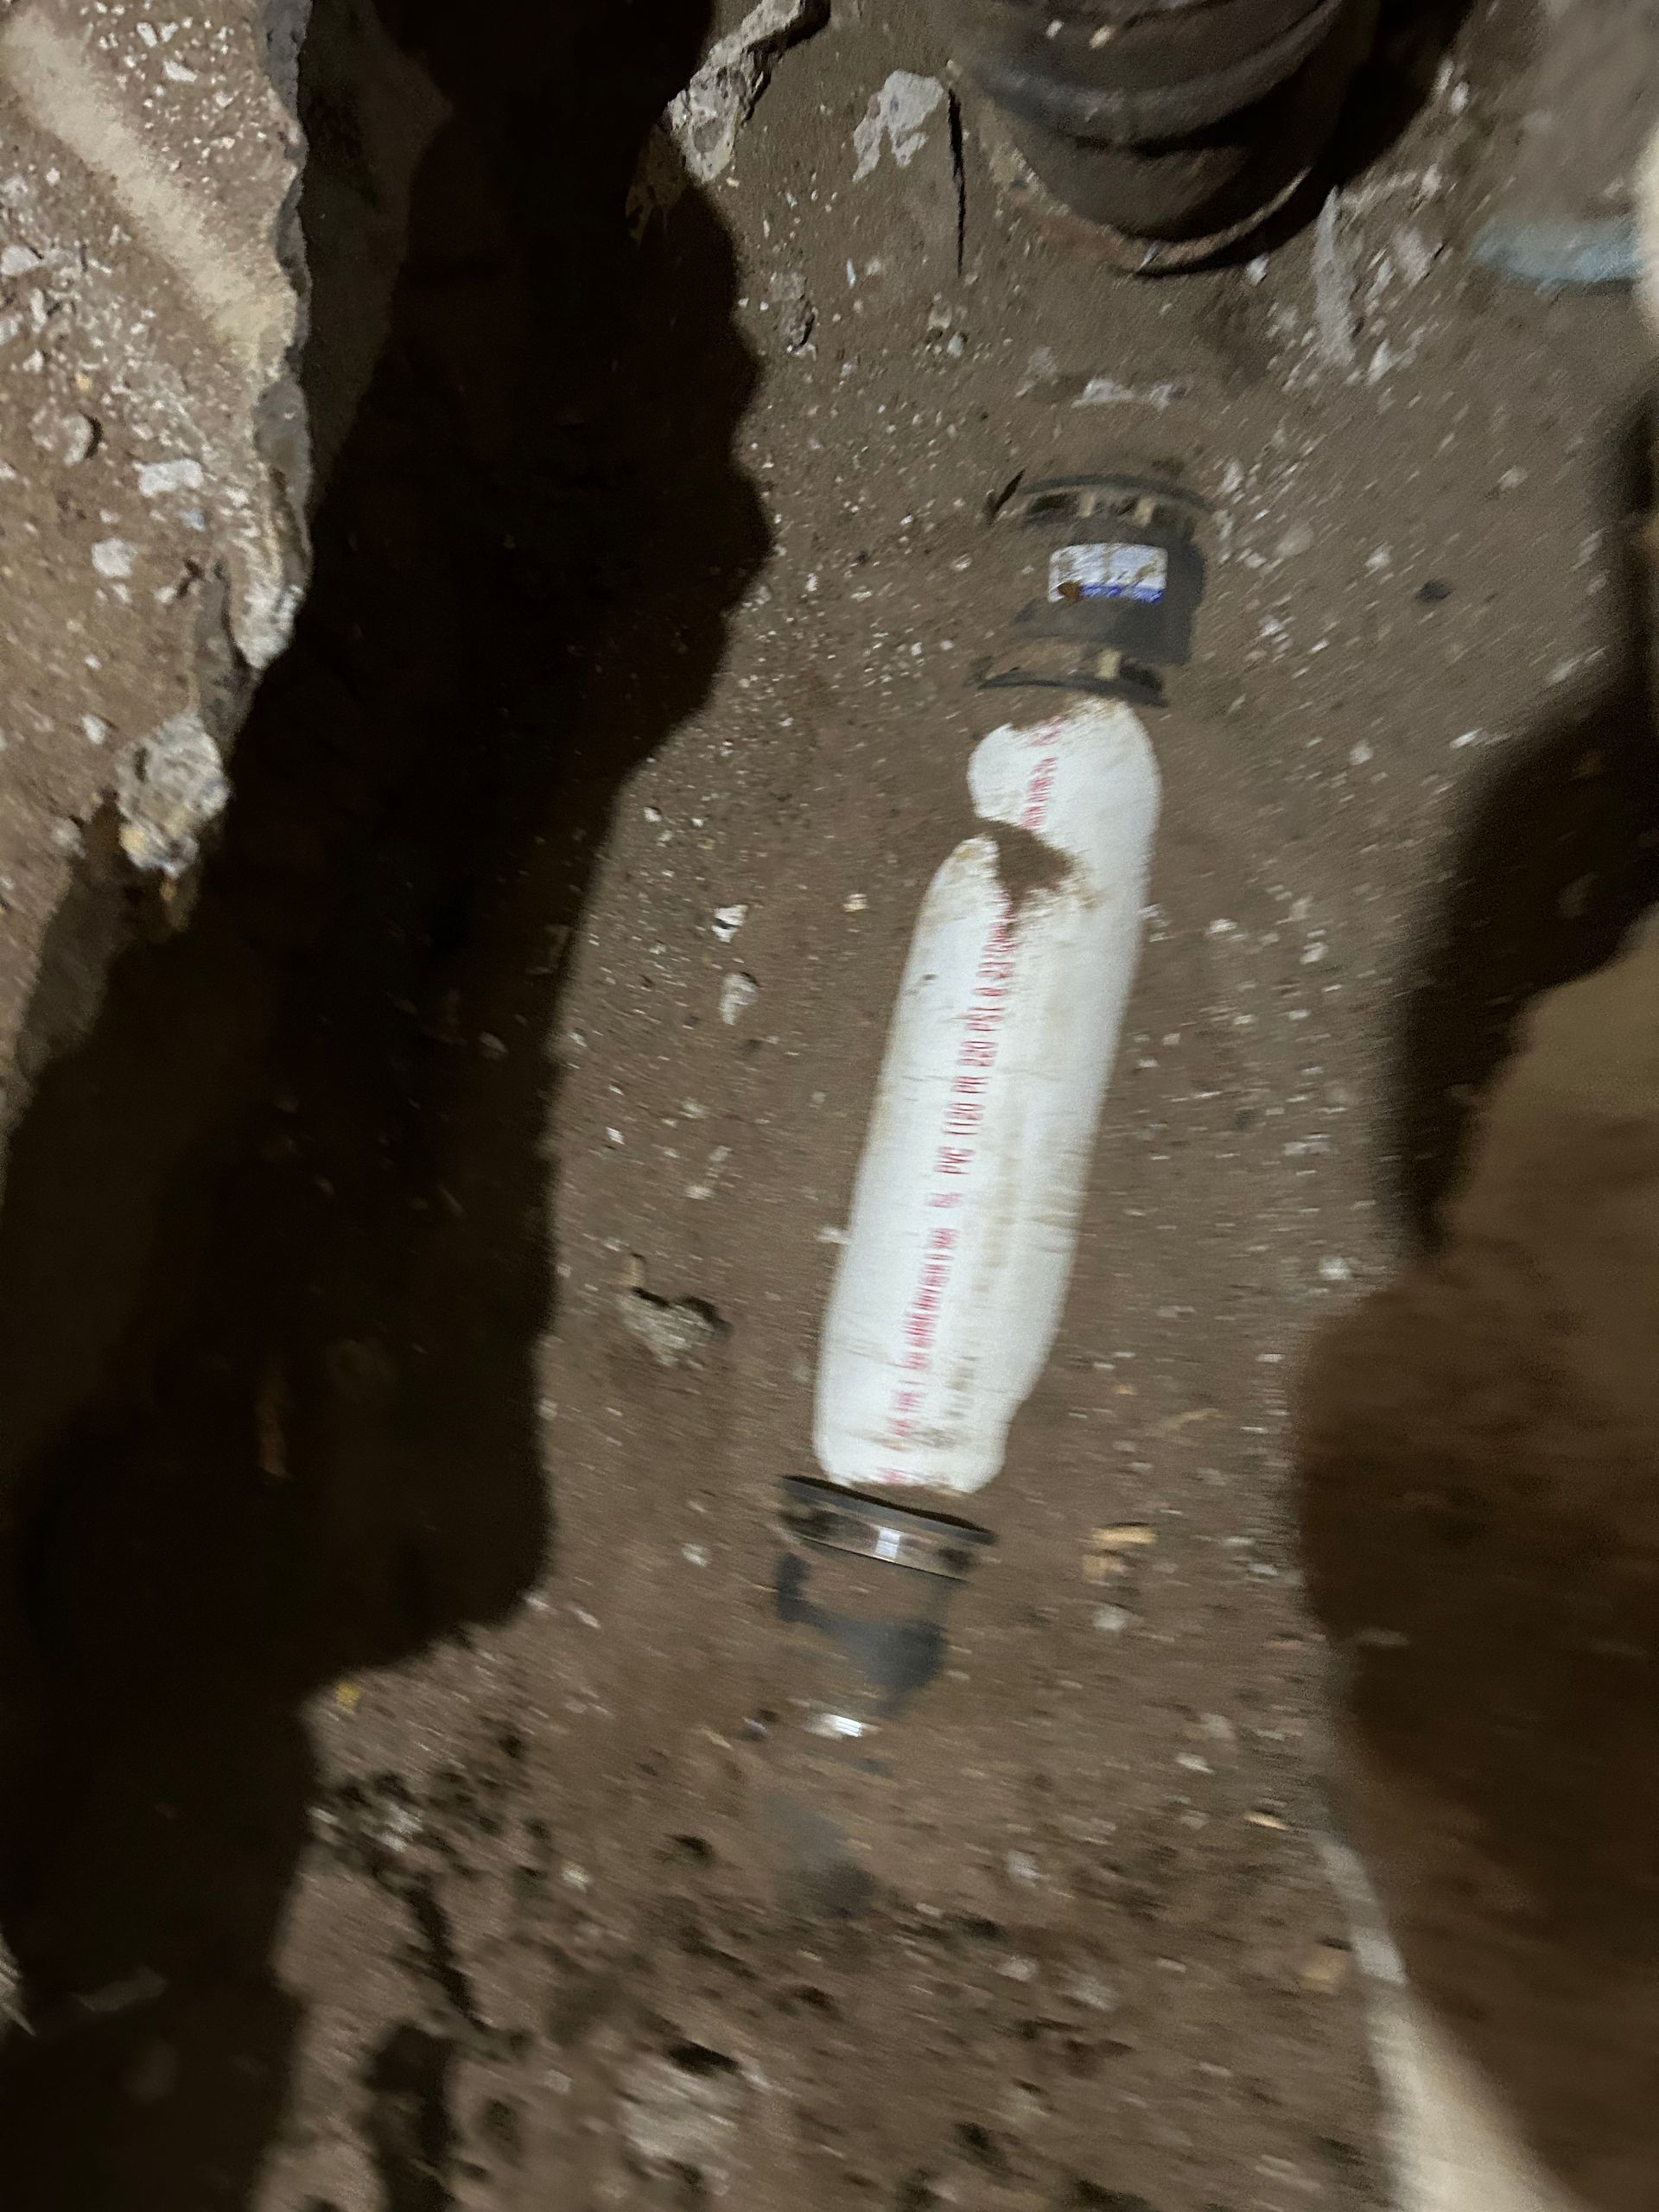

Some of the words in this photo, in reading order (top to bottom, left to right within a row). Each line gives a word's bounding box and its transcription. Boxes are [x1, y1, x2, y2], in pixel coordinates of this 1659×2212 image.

[963, 1006, 1005, 1032] PSI
[957, 1040, 998, 1067] 220
[950, 1076, 988, 1094] PR
[942, 1103, 985, 1135] 1120
[933, 1147, 975, 1175] PVC
